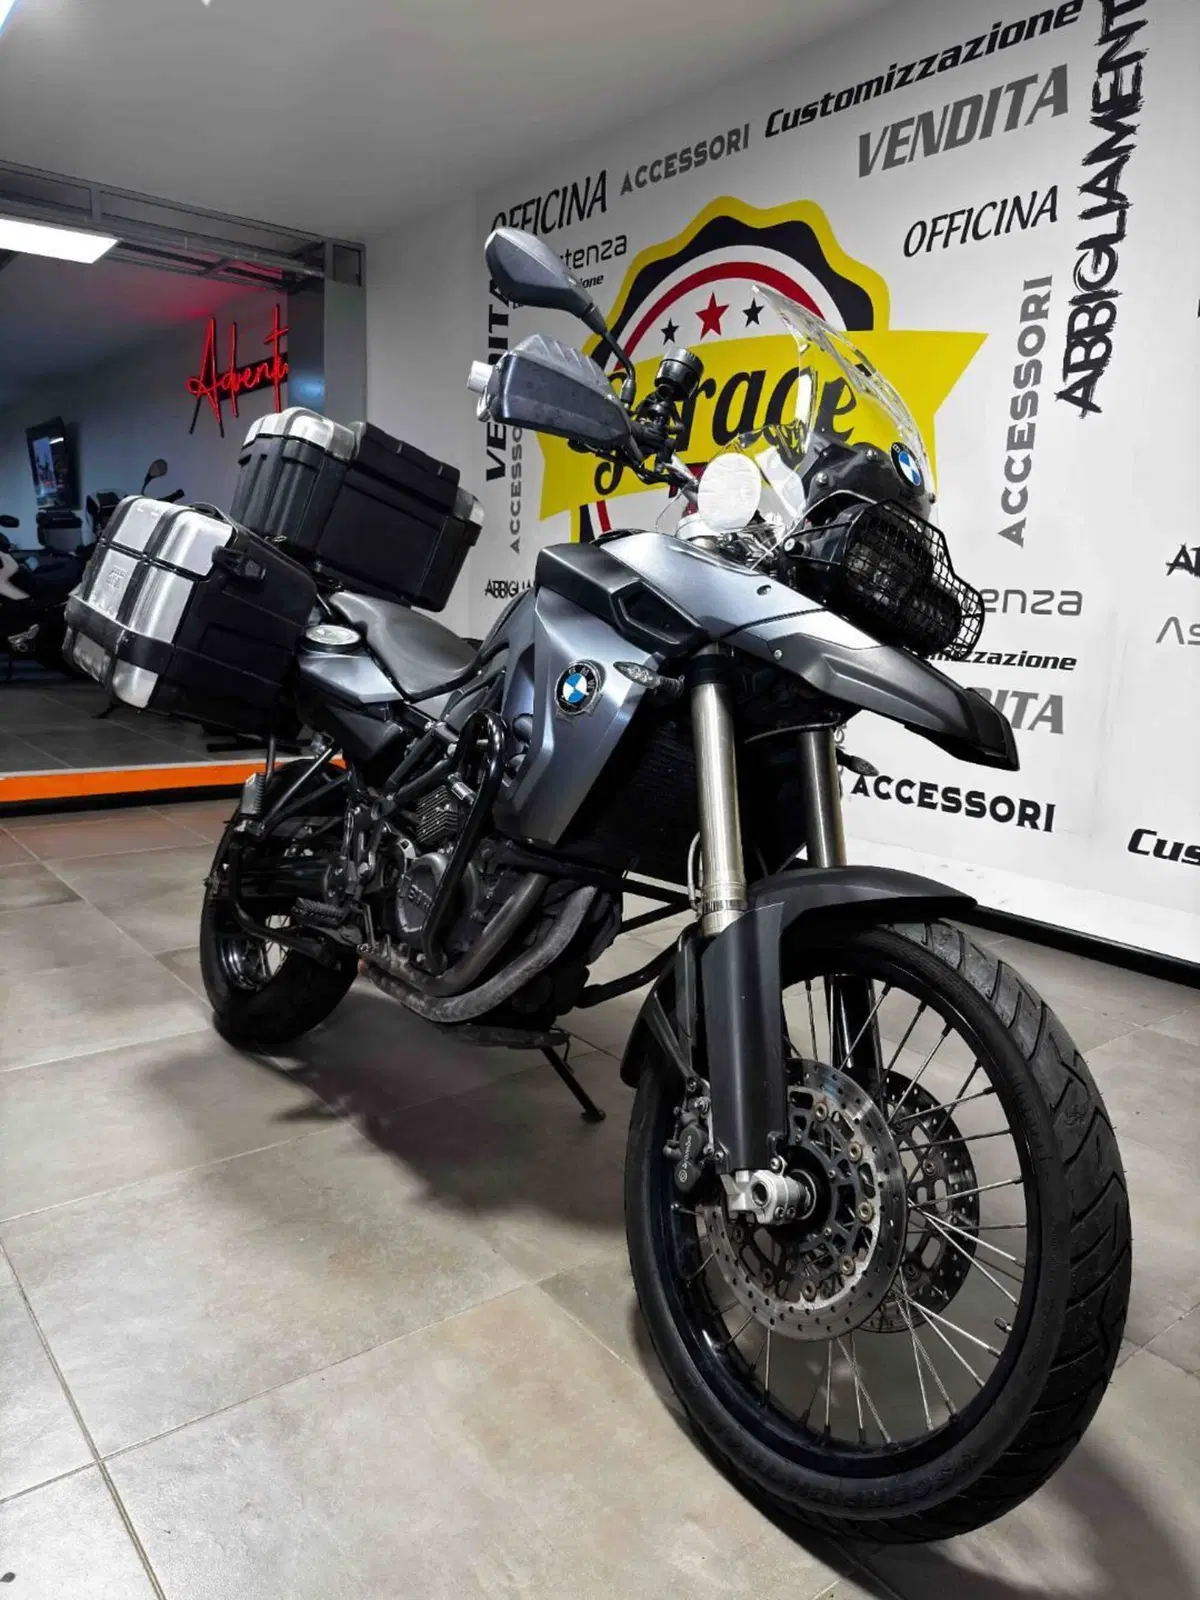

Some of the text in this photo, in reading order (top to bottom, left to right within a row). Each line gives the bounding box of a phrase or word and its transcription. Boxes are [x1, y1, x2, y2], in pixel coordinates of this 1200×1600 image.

[765, 0, 1084, 138] Customizzazione
[620, 123, 751, 196] ACCESSORI
[858, 63, 1069, 178] VENDITA
[903, 185, 1058, 258] OFFICINA
[997, 274, 1053, 549] ACCESSORI
[850, 775, 1056, 833] ACCESSORI
